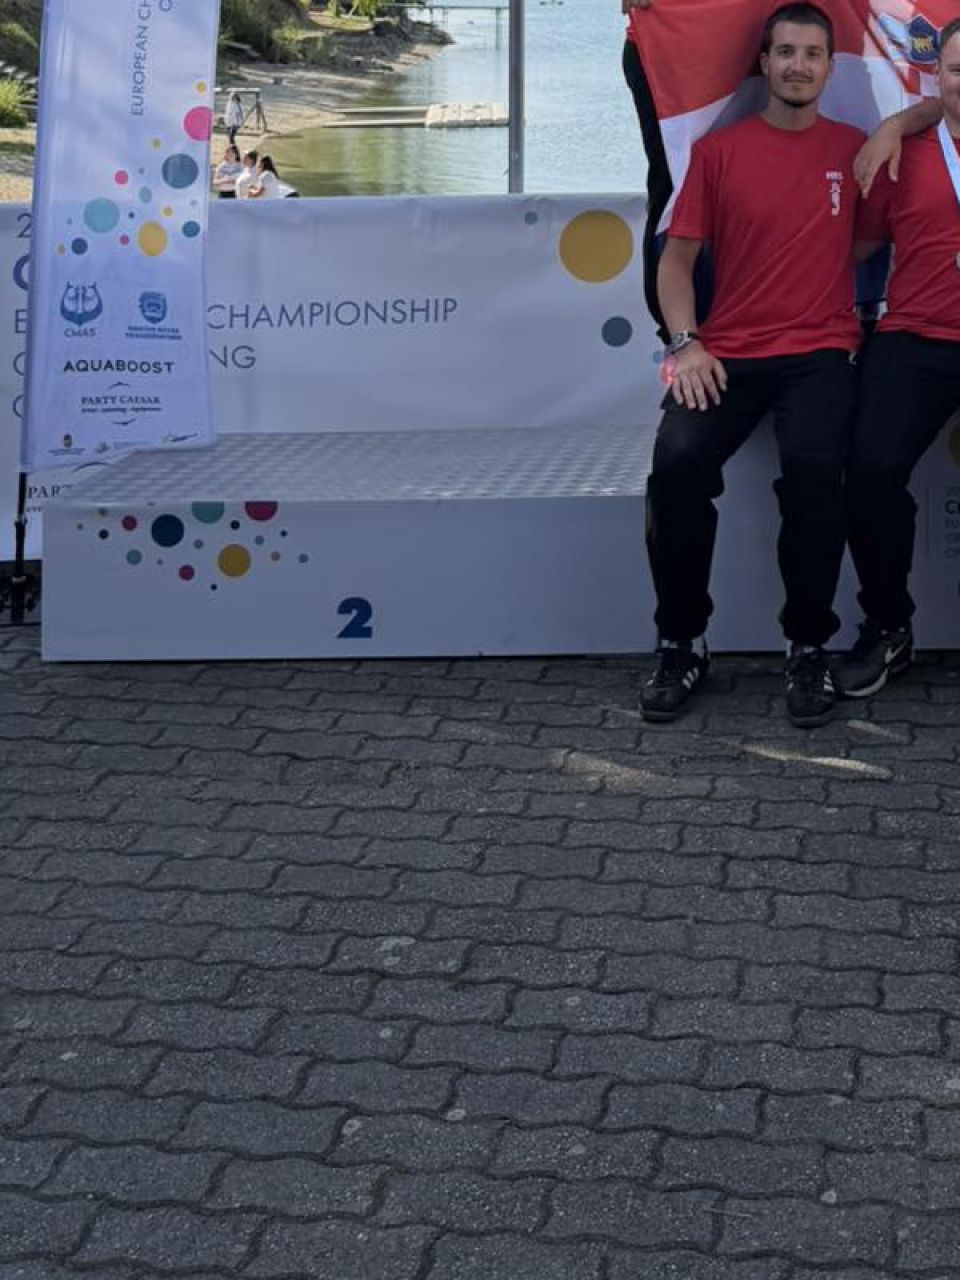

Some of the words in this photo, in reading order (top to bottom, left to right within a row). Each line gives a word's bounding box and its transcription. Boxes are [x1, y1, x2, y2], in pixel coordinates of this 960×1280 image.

[130, 24, 150, 116] EUROPEAN
[206, 298, 458, 329] CHAMPIONSHIP
[63, 359, 175, 374] AQUABOOST
[28, 485, 73, 499] PAR
[336, 597, 373, 639] 2
